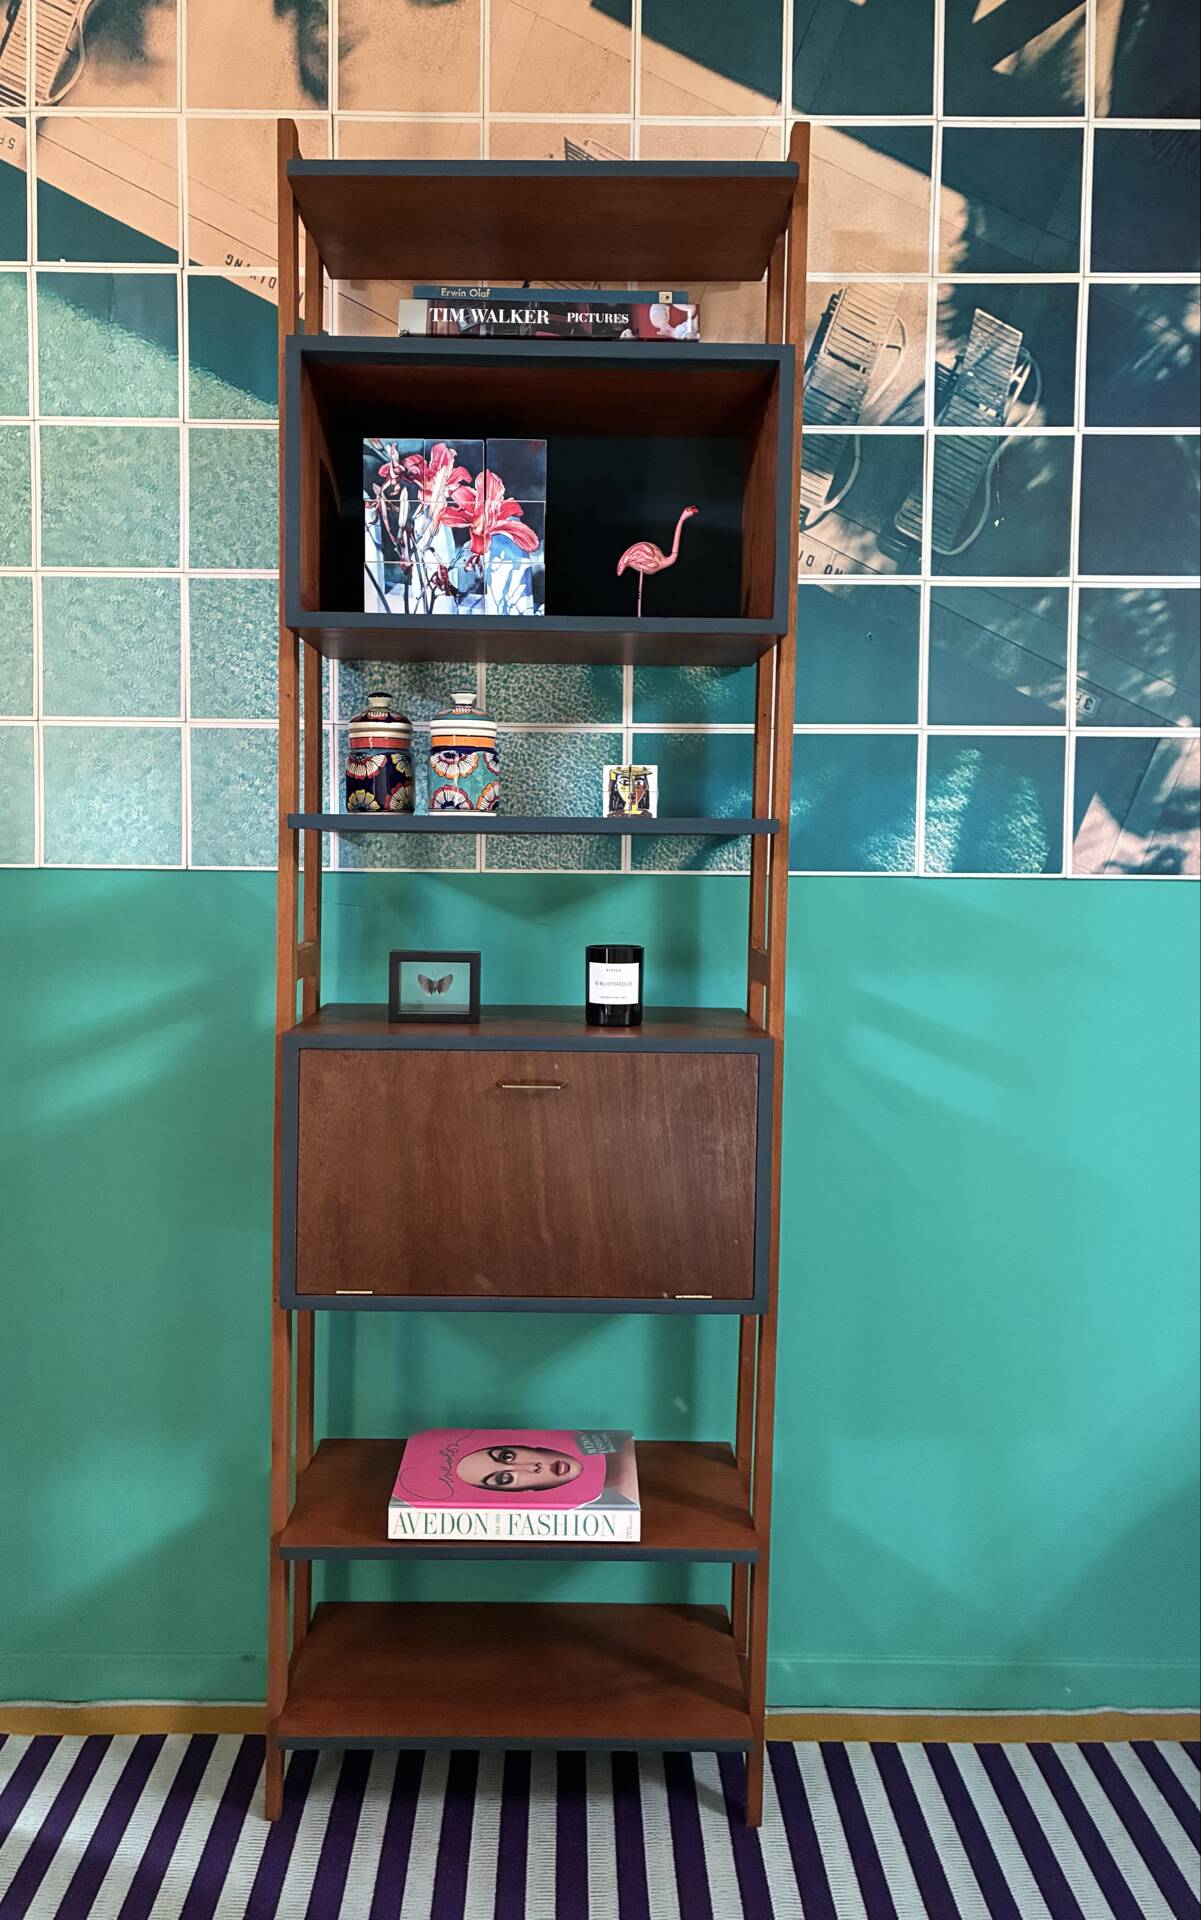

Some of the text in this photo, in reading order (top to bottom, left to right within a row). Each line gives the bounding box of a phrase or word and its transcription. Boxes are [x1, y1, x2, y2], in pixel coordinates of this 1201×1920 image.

[7, 137, 16, 150] 5
[225, 254, 277, 289] DING
[441, 288, 491, 298] Erwin Olaf
[429, 307, 630, 324] TIM WALKER PICTURES
[1083, 698, 1094, 710] 3
[391, 1512, 489, 1536] AVEDON
[508, 1513, 617, 1537] FASHION
